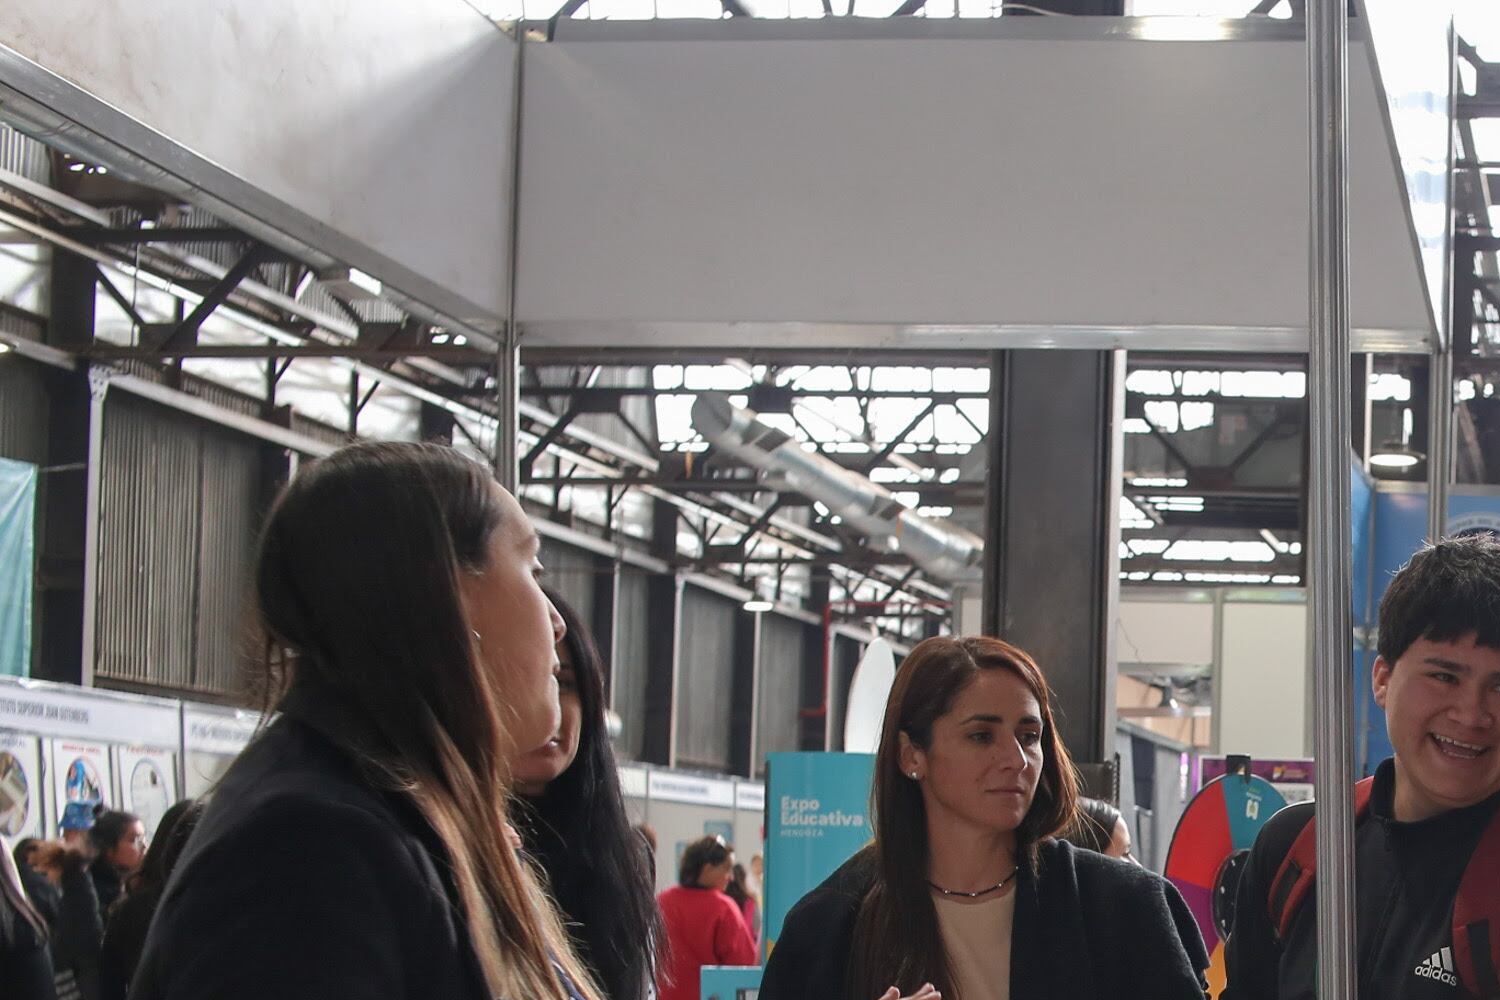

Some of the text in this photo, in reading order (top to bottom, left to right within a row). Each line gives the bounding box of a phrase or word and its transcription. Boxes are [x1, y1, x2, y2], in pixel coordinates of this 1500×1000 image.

[780, 796, 820, 812] Expo
[780, 810, 863, 826] Educativa
[1414, 964, 1457, 986] adidas
